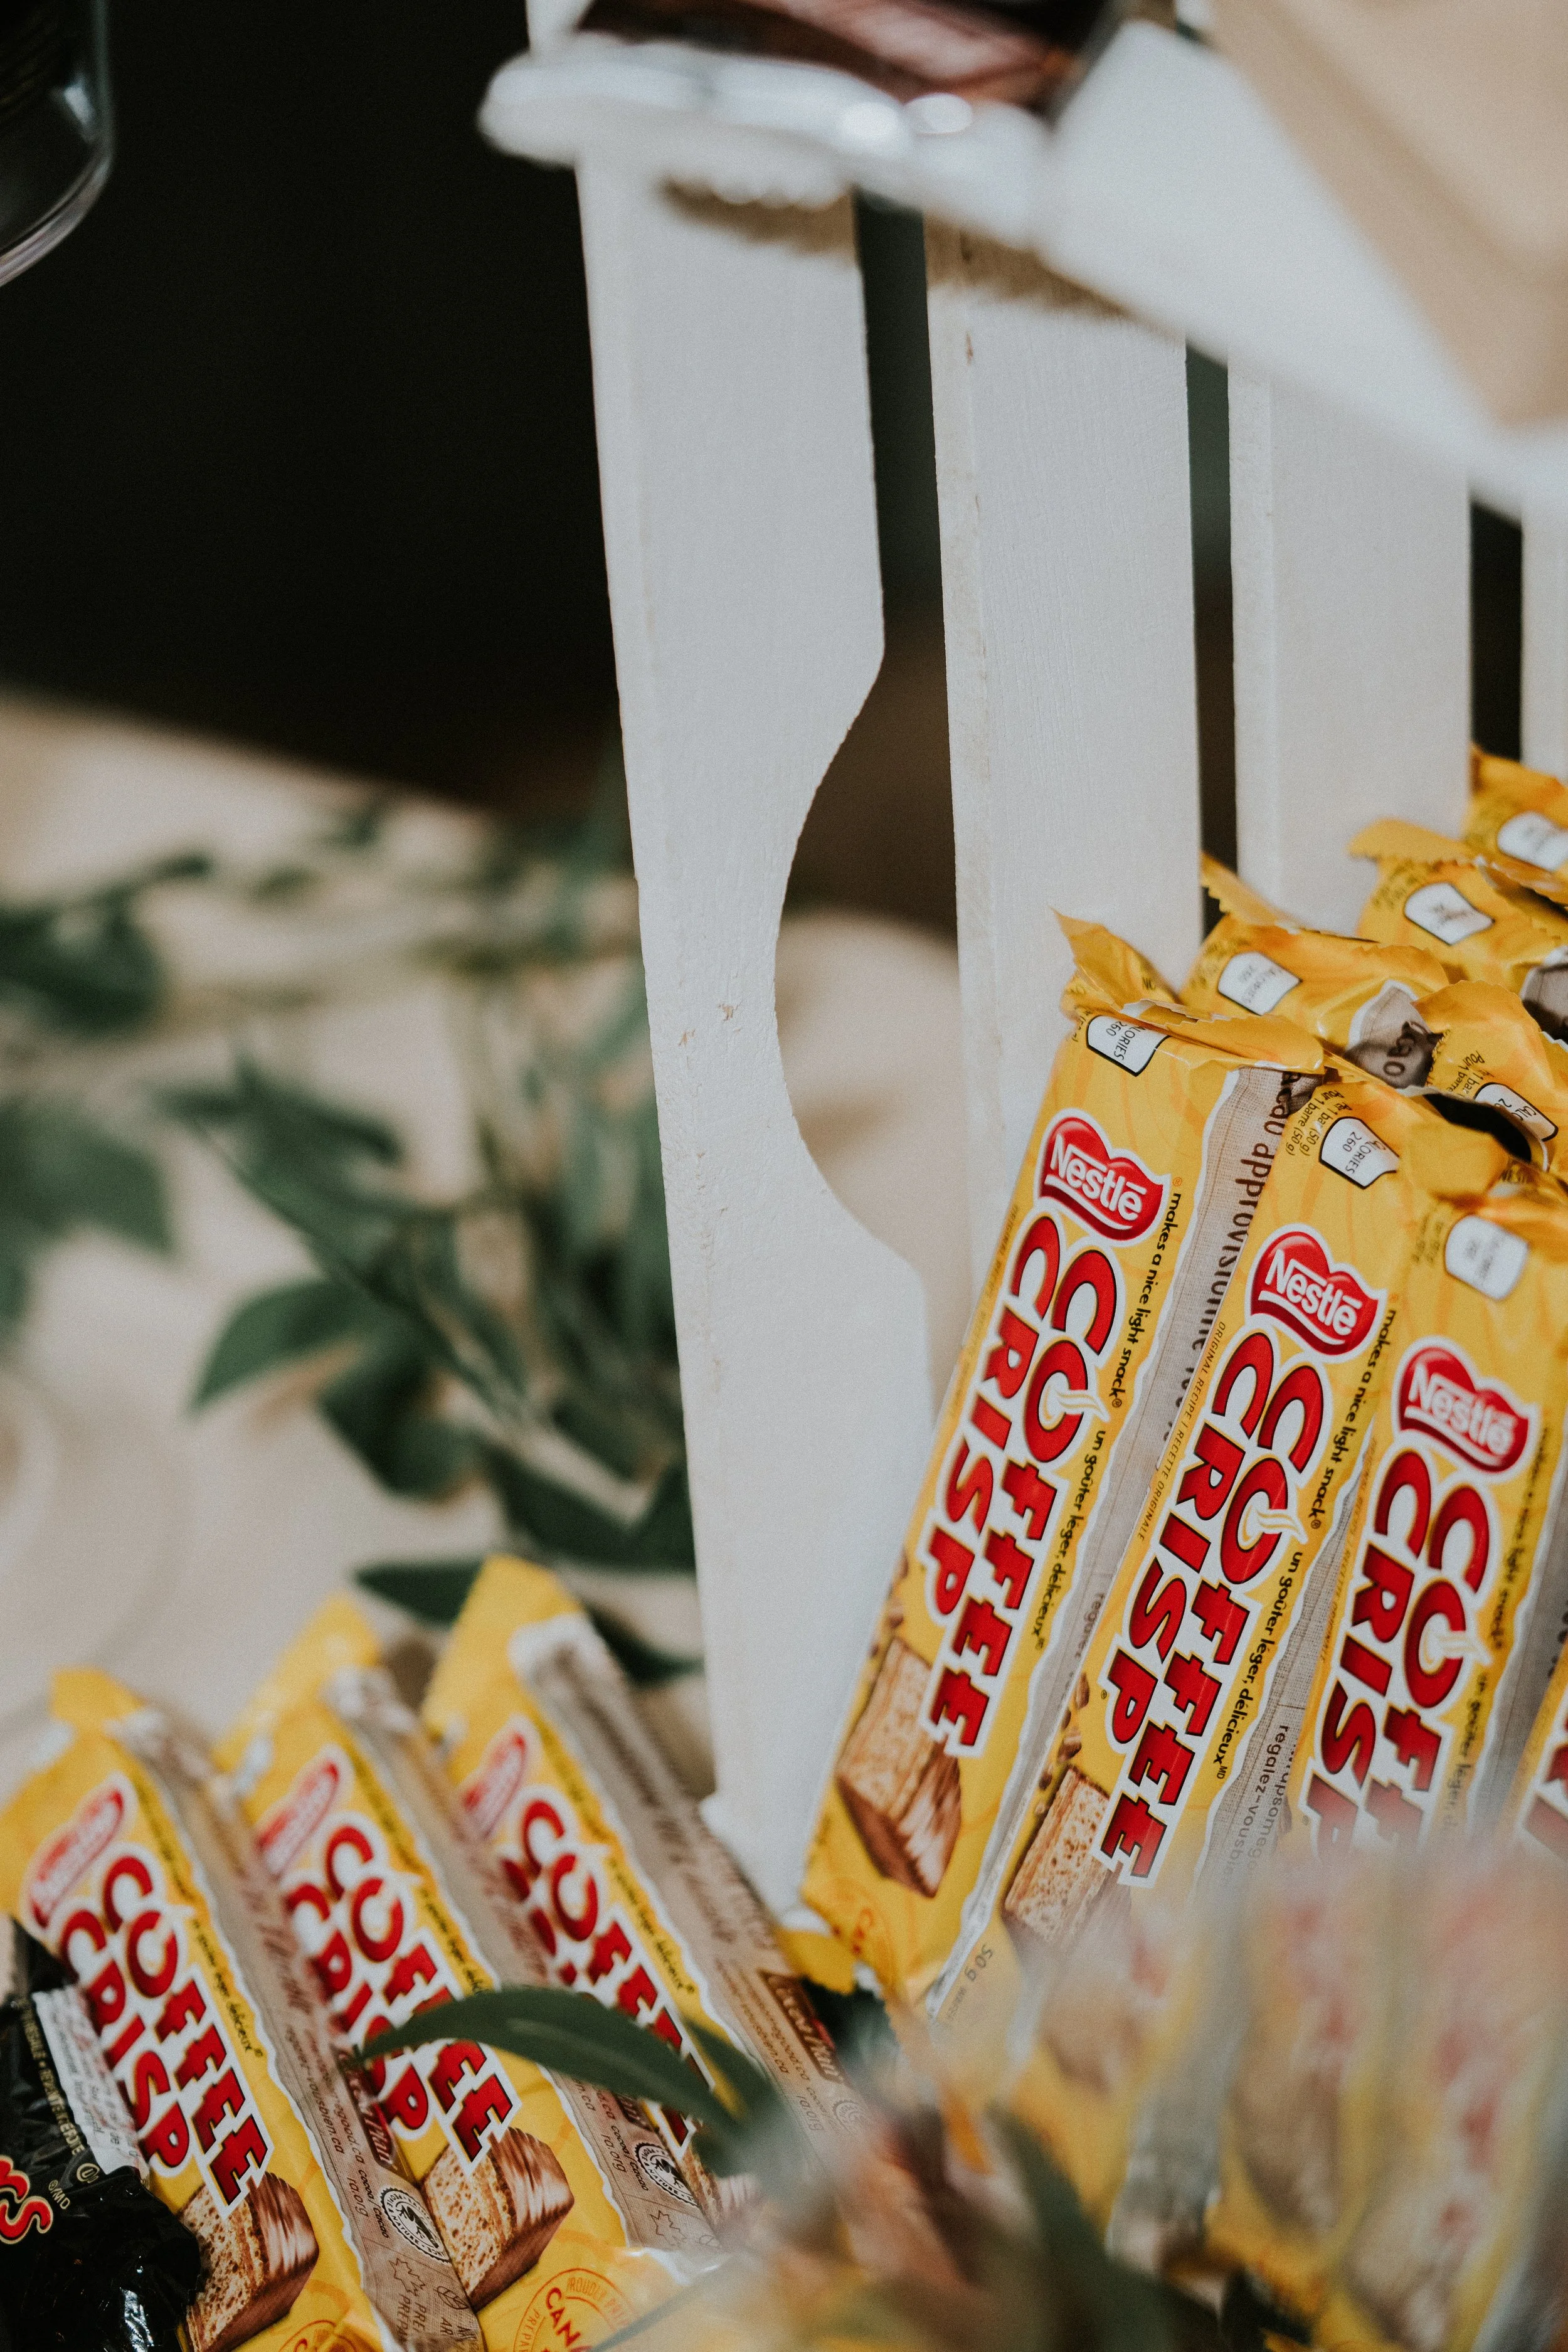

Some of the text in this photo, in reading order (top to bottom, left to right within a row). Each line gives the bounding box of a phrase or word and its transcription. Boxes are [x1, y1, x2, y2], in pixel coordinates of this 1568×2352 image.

[1106, 1020, 1128, 1037] 260
[1298, 1102, 1320, 1127] barre
[1342, 1131, 1362, 1152] 260
[1345, 1140, 1386, 1174] CALORIES
[1157, 1193, 1182, 1251] makes
[1153, 1254, 1162, 1266] a
[1139, 1269, 1158, 1304] nice
[1128, 1306, 1152, 1344] light
[1371, 1309, 1396, 1369] makes
[1200, 1321, 1226, 1374] ORIGINAL
[1361, 1371, 1372, 1383] a
[928, 1216, 1060, 1614] CRISP
[1185, 1379, 1204, 1421] RECIPE
[1346, 1387, 1366, 1422] nice
[1092, 1430, 1106, 1450] un
[1163, 1431, 1185, 1479] RECETTE
[1333, 1426, 1357, 1463] light
[929, 1249, 1116, 1746] COFFEE
[1074, 1454, 1094, 1511] goûter
[1140, 1481, 1165, 1542] ORIGINALE
[1107, 1332, 1274, 1744] CRISP
[1290, 1551, 1303, 1573] un
[1101, 1365, 1324, 1878] COFFEE
[1264, 1577, 1293, 1636] goûter
[1241, 1641, 1276, 1684] léger,
[59, 1910, 189, 2168] CRISP
[102, 1857, 268, 2205] COFFEE
[601, 2133, 627, 2173] ra.org
[347, 2176, 370, 2218] ra.org
